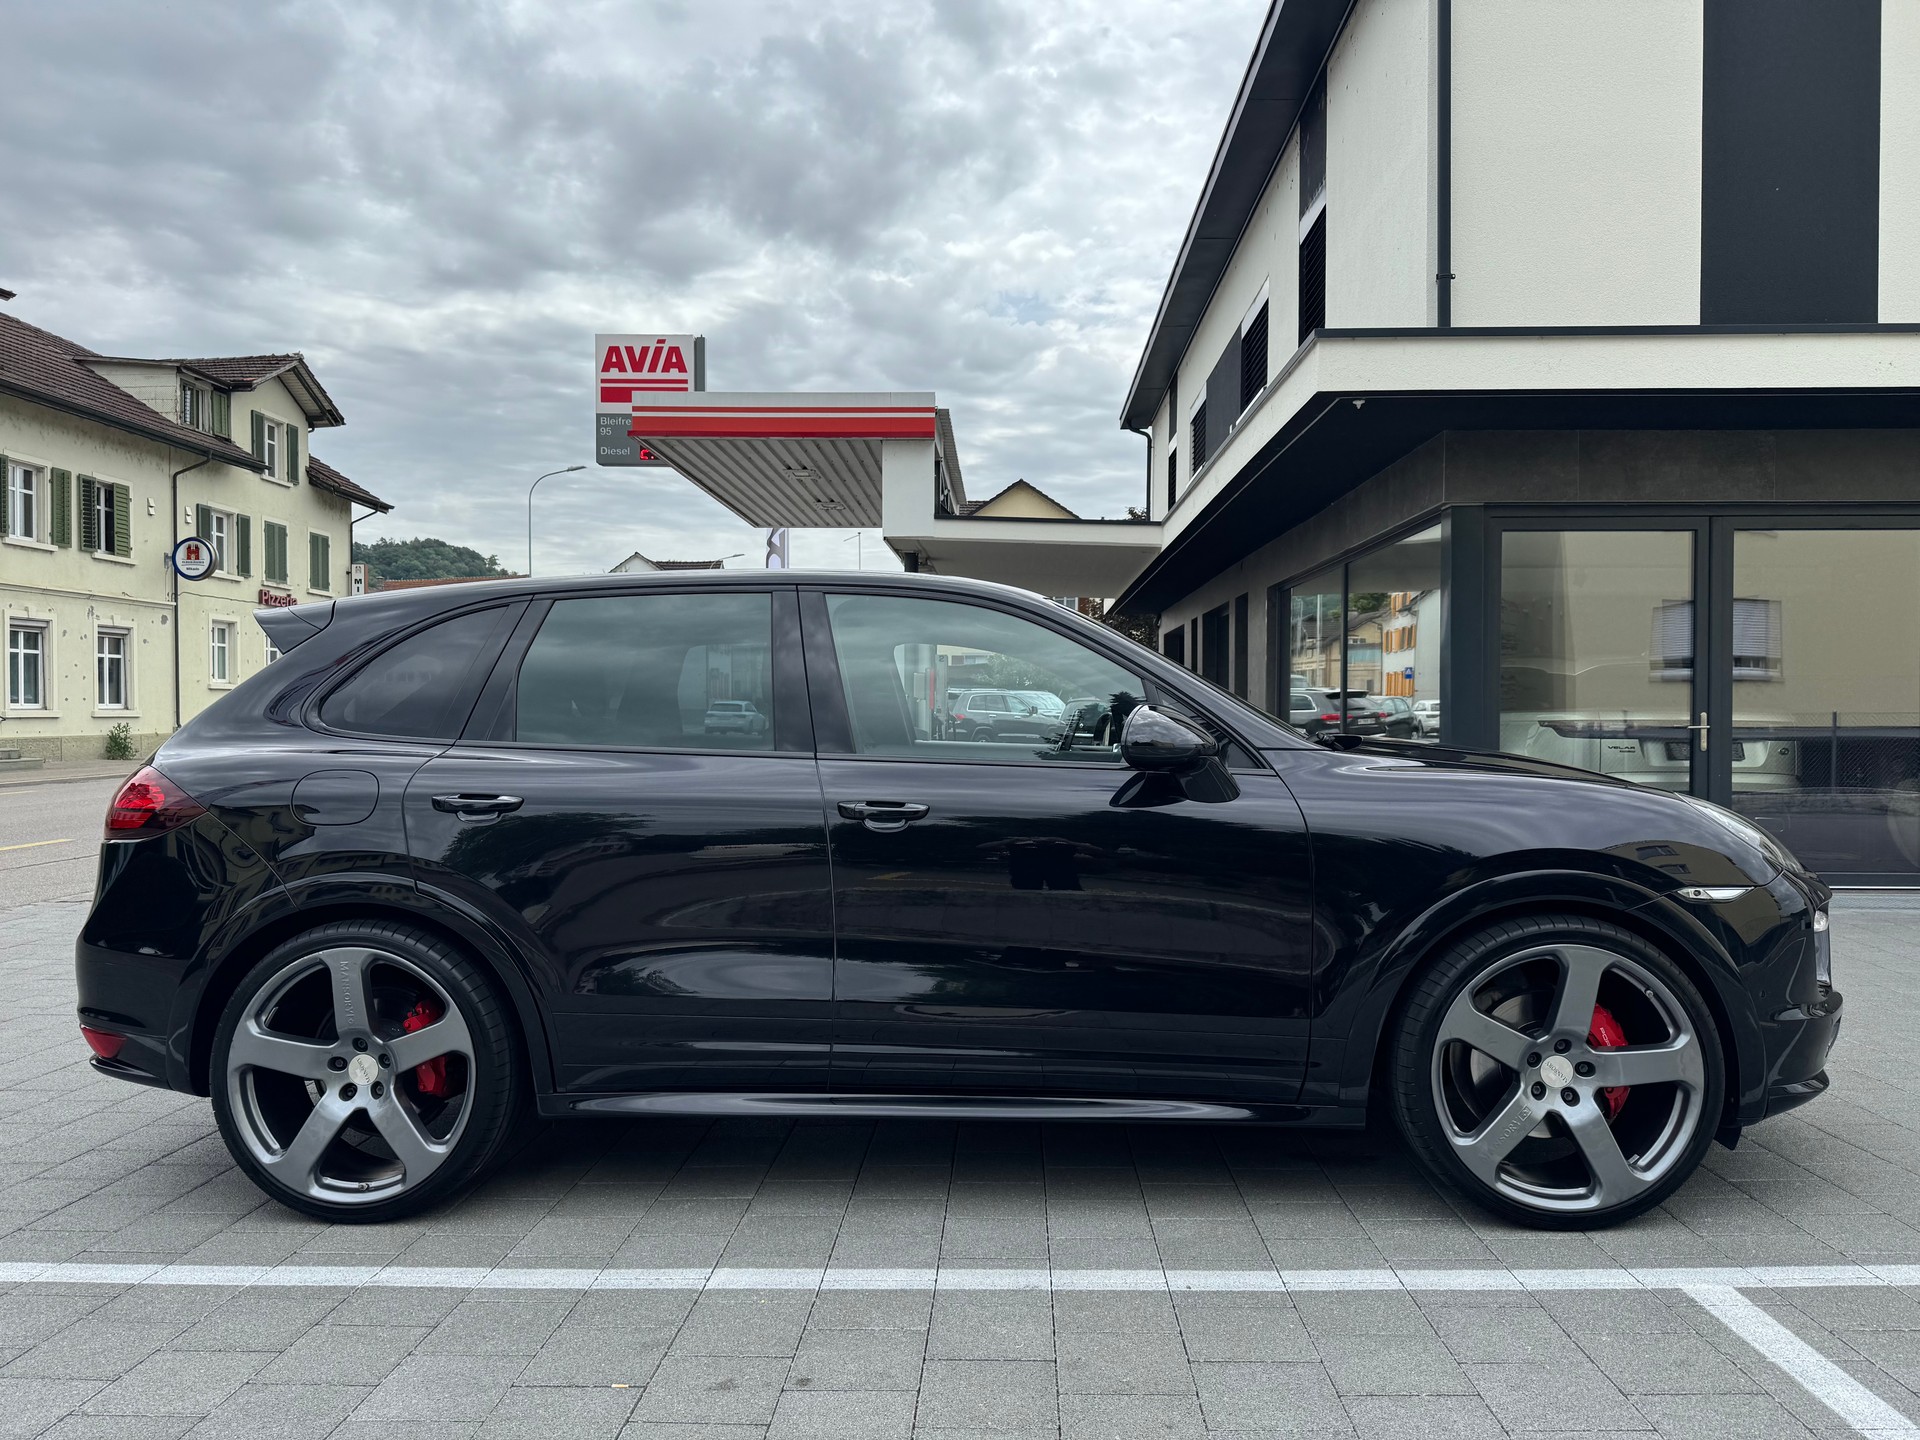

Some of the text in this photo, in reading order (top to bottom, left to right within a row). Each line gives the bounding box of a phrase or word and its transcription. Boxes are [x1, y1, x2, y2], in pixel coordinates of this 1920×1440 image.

[600, 417, 632, 426] Bleifre
[600, 427, 612, 436] 95
[600, 446, 631, 455] Diesel
